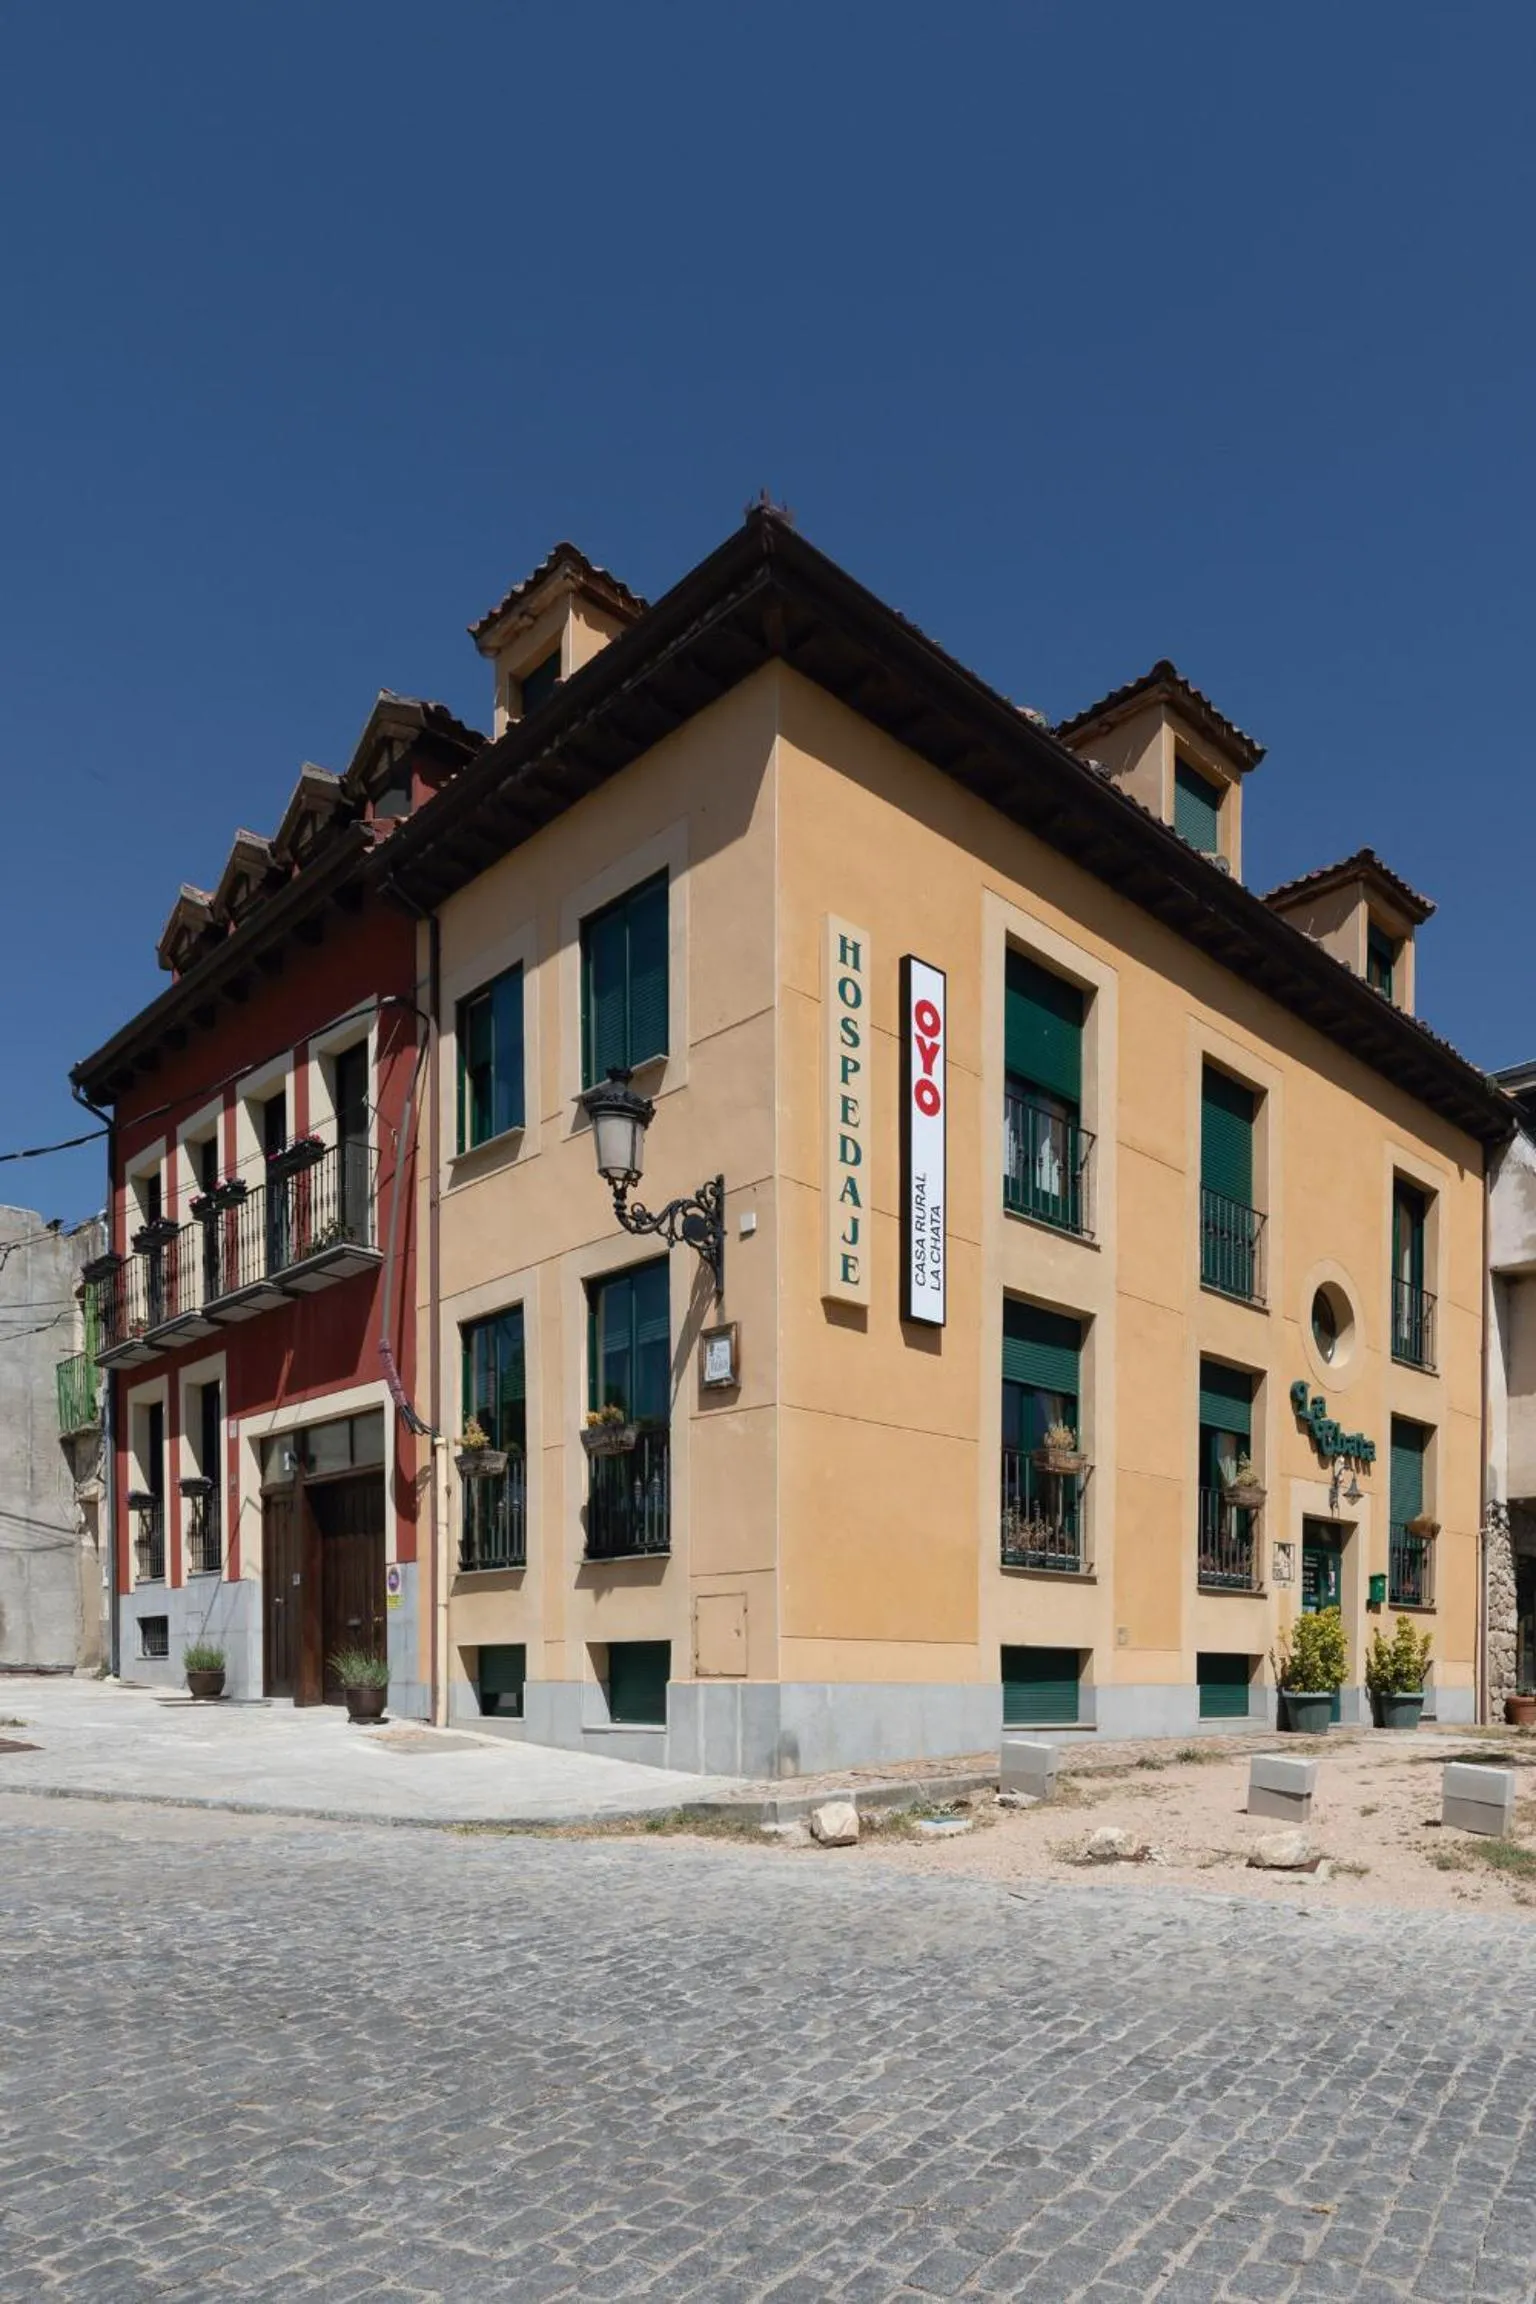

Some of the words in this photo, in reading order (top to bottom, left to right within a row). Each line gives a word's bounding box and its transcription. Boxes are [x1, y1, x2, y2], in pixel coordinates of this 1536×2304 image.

[914, 999, 941, 1117] OYO
[838, 933, 862, 1285] HOSPEDAJE
[914, 1172, 927, 1233] RURAL
[914, 1238, 927, 1287] CASA
[930, 1205, 941, 1264] CHATA
[930, 1269, 941, 1291] LA
[1290, 1380, 1326, 1421] La
